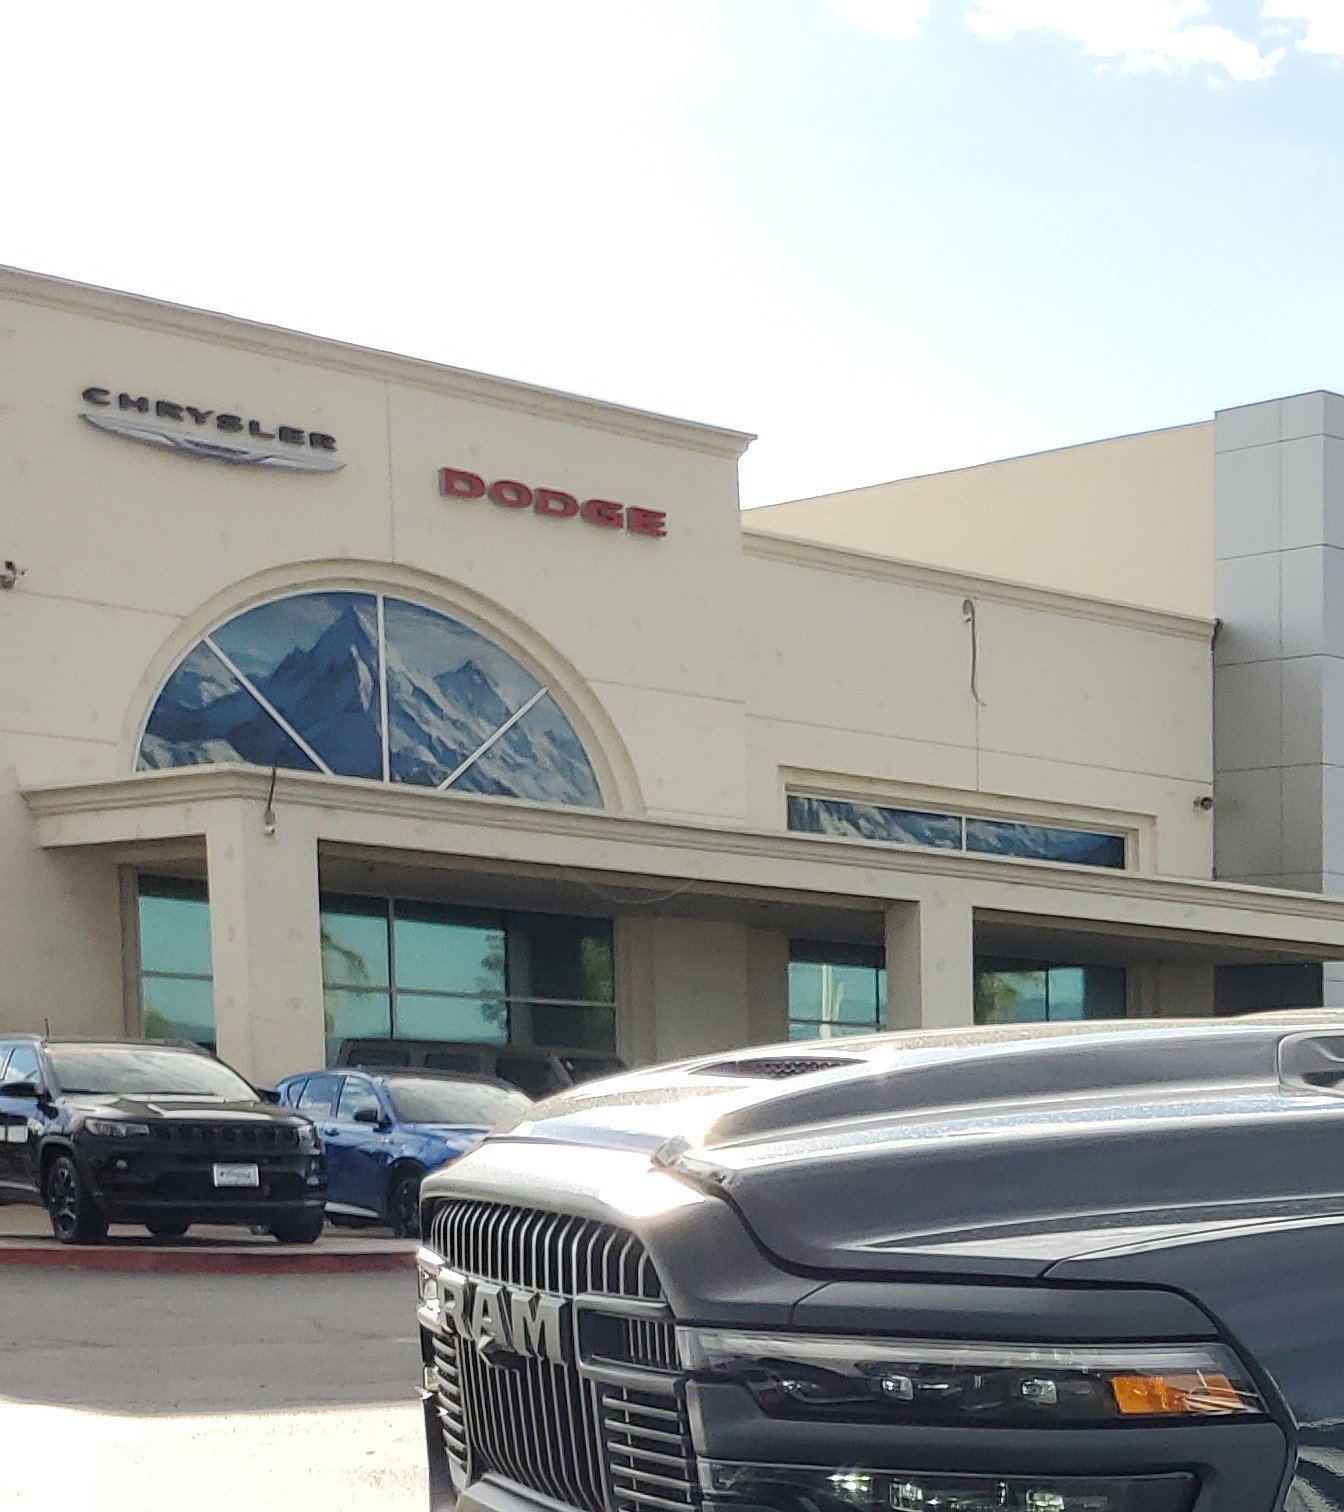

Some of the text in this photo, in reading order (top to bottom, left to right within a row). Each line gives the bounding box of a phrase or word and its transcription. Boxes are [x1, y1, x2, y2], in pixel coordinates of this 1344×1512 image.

[82, 386, 338, 452] CHRYSLER
[438, 465, 668, 538] DODGE
[437, 1267, 570, 1366] RAM
